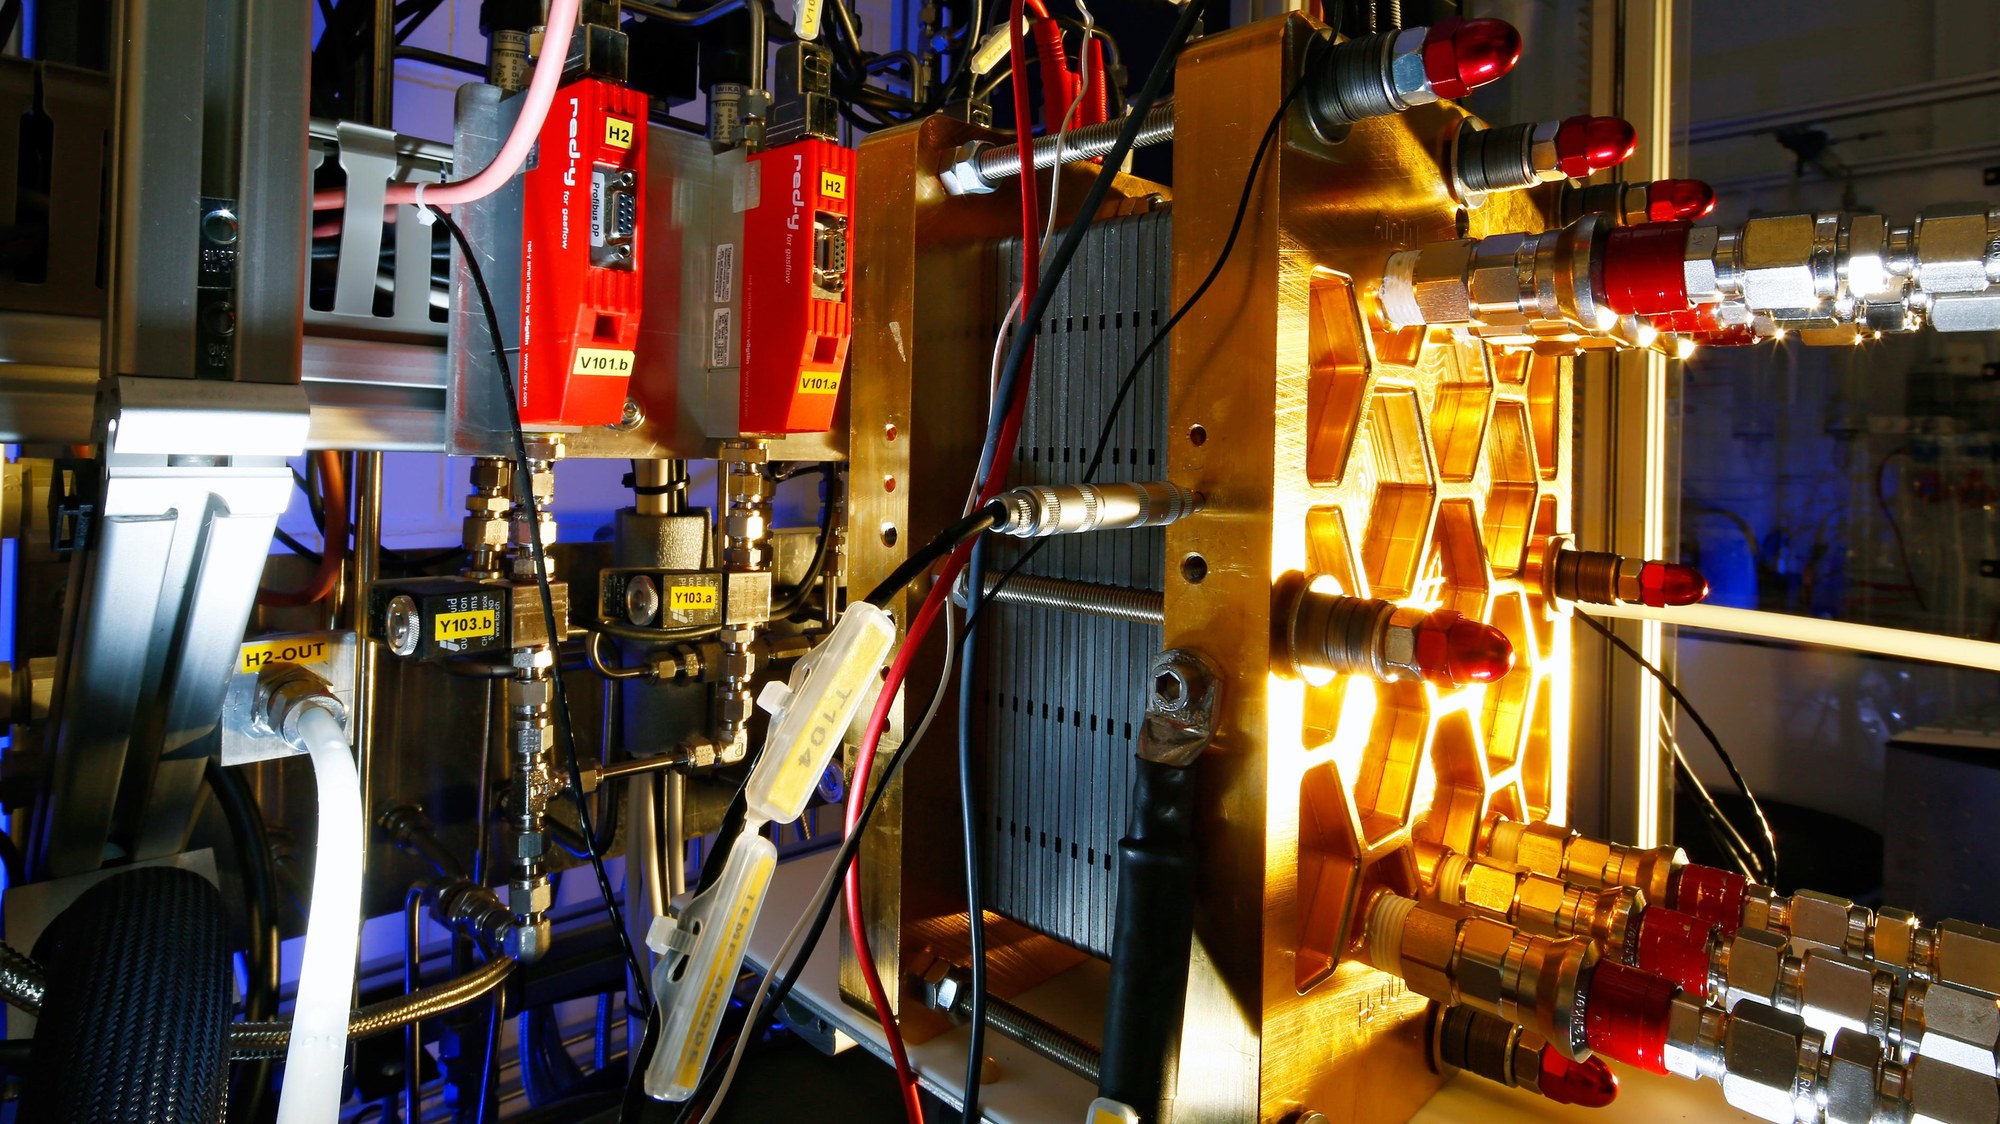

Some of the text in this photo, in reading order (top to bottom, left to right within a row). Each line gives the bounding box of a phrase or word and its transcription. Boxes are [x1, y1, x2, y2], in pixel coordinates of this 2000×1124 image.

[501, 33, 525, 41] WIKA
[563, 97, 581, 187] red-y
[609, 126, 630, 143] H2
[786, 154, 805, 231] red-y
[825, 179, 841, 194] H2
[591, 182, 600, 238] Profibus DP
[561, 207, 570, 250] gasflow
[784, 248, 793, 284] gasflow
[581, 355, 629, 372] V101.b
[802, 377, 838, 391] V101.a
[674, 591, 713, 604] Y103.a
[440, 616, 492, 633] Y103.b
[246, 642, 325, 667] H2-OUT
[798, 686, 852, 769] T104
[688, 893, 757, 1066] TEMP ANODE
